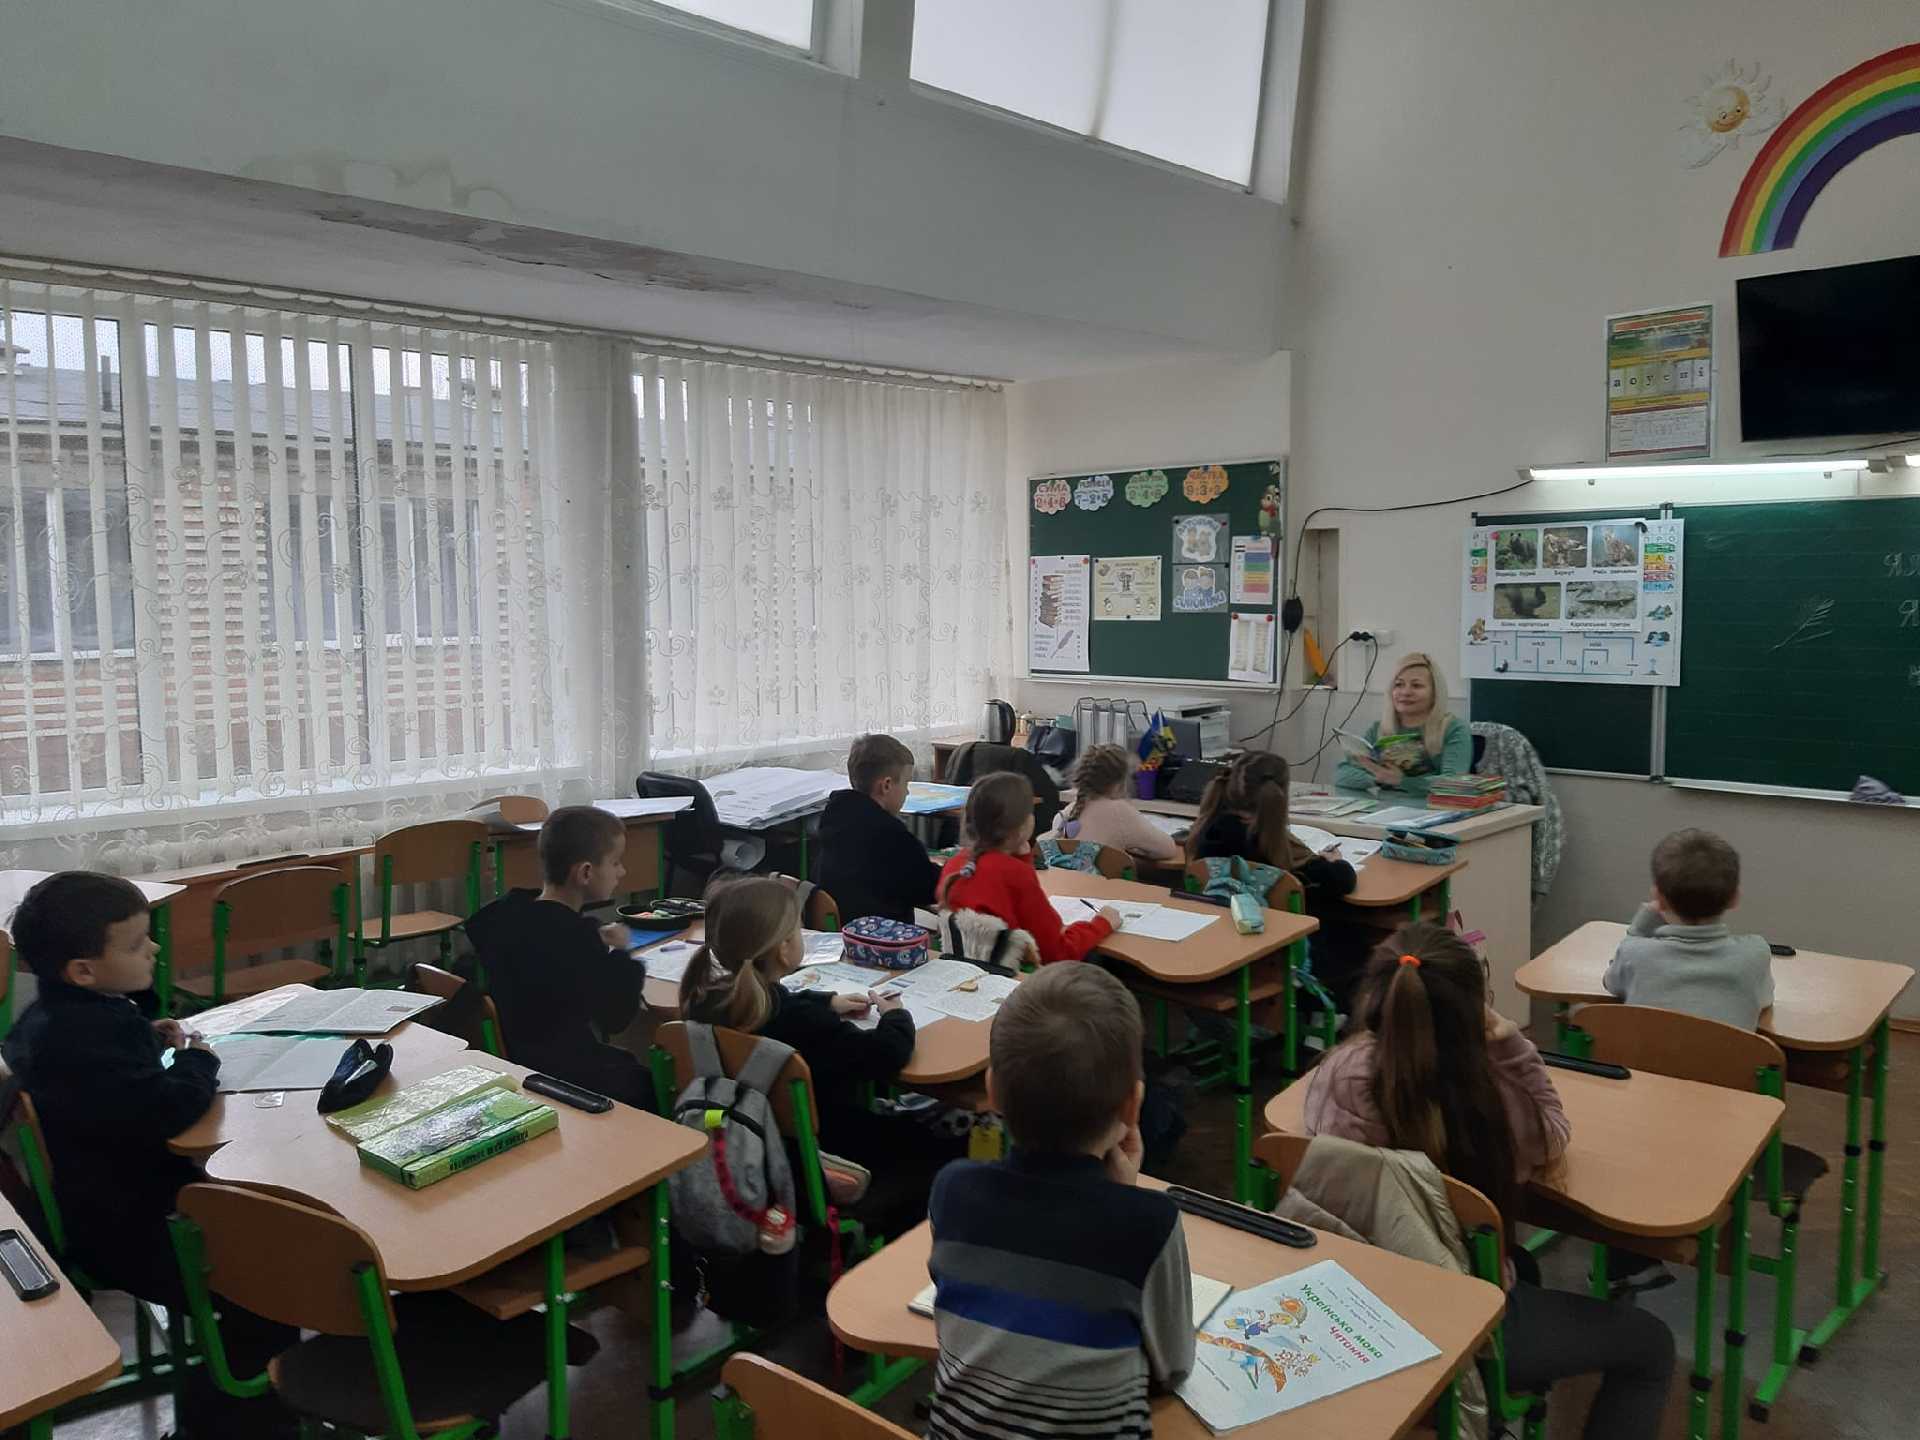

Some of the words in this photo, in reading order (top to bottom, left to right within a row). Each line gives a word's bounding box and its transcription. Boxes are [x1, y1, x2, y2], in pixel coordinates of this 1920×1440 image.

[1300, 1283, 1353, 1334] Українська
[1353, 1334, 1383, 1359] мова
[1329, 1325, 1370, 1364] Читання
